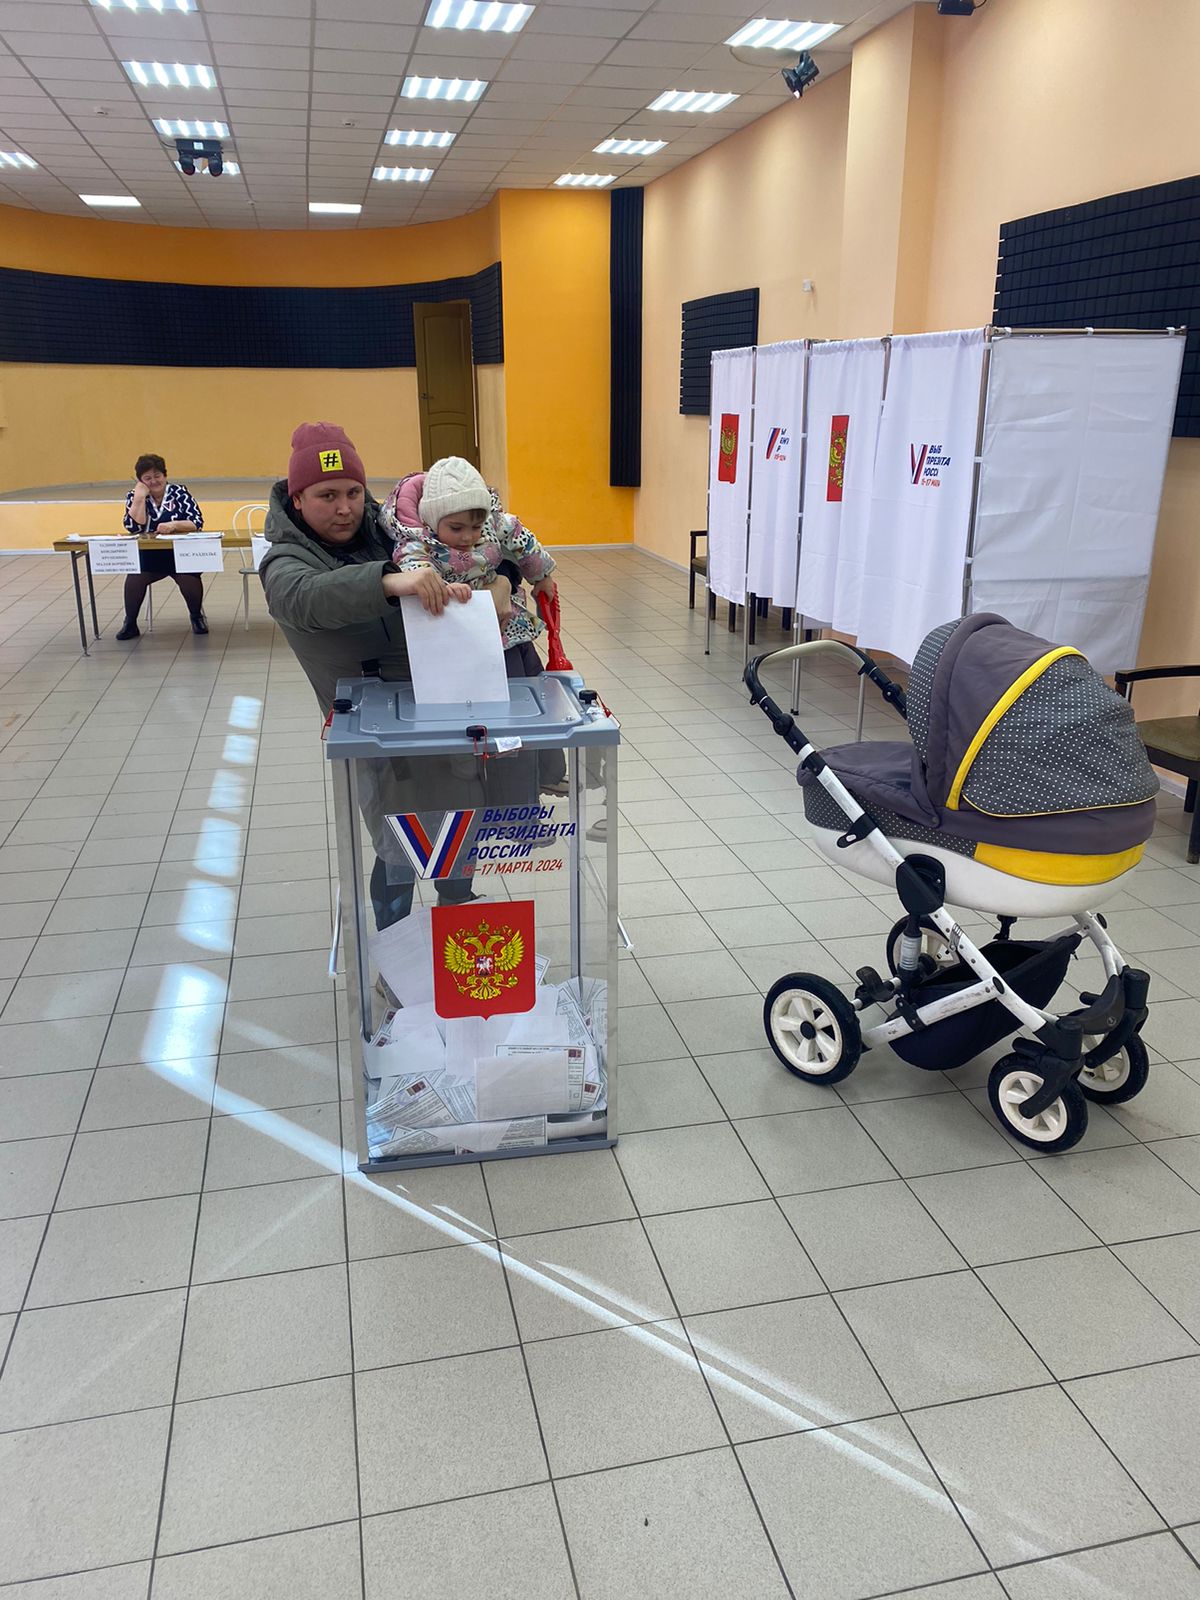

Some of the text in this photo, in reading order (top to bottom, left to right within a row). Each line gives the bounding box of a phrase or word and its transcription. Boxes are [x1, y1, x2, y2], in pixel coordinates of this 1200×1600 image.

[482, 805, 556, 823] ВЫБОРЫ
[474, 822, 577, 842] ПРЕЗИДЕНТА
[466, 843, 534, 861] РОССИИ
[494, 861, 534, 875] МАРТА
[535, 858, 564, 872] 2024
